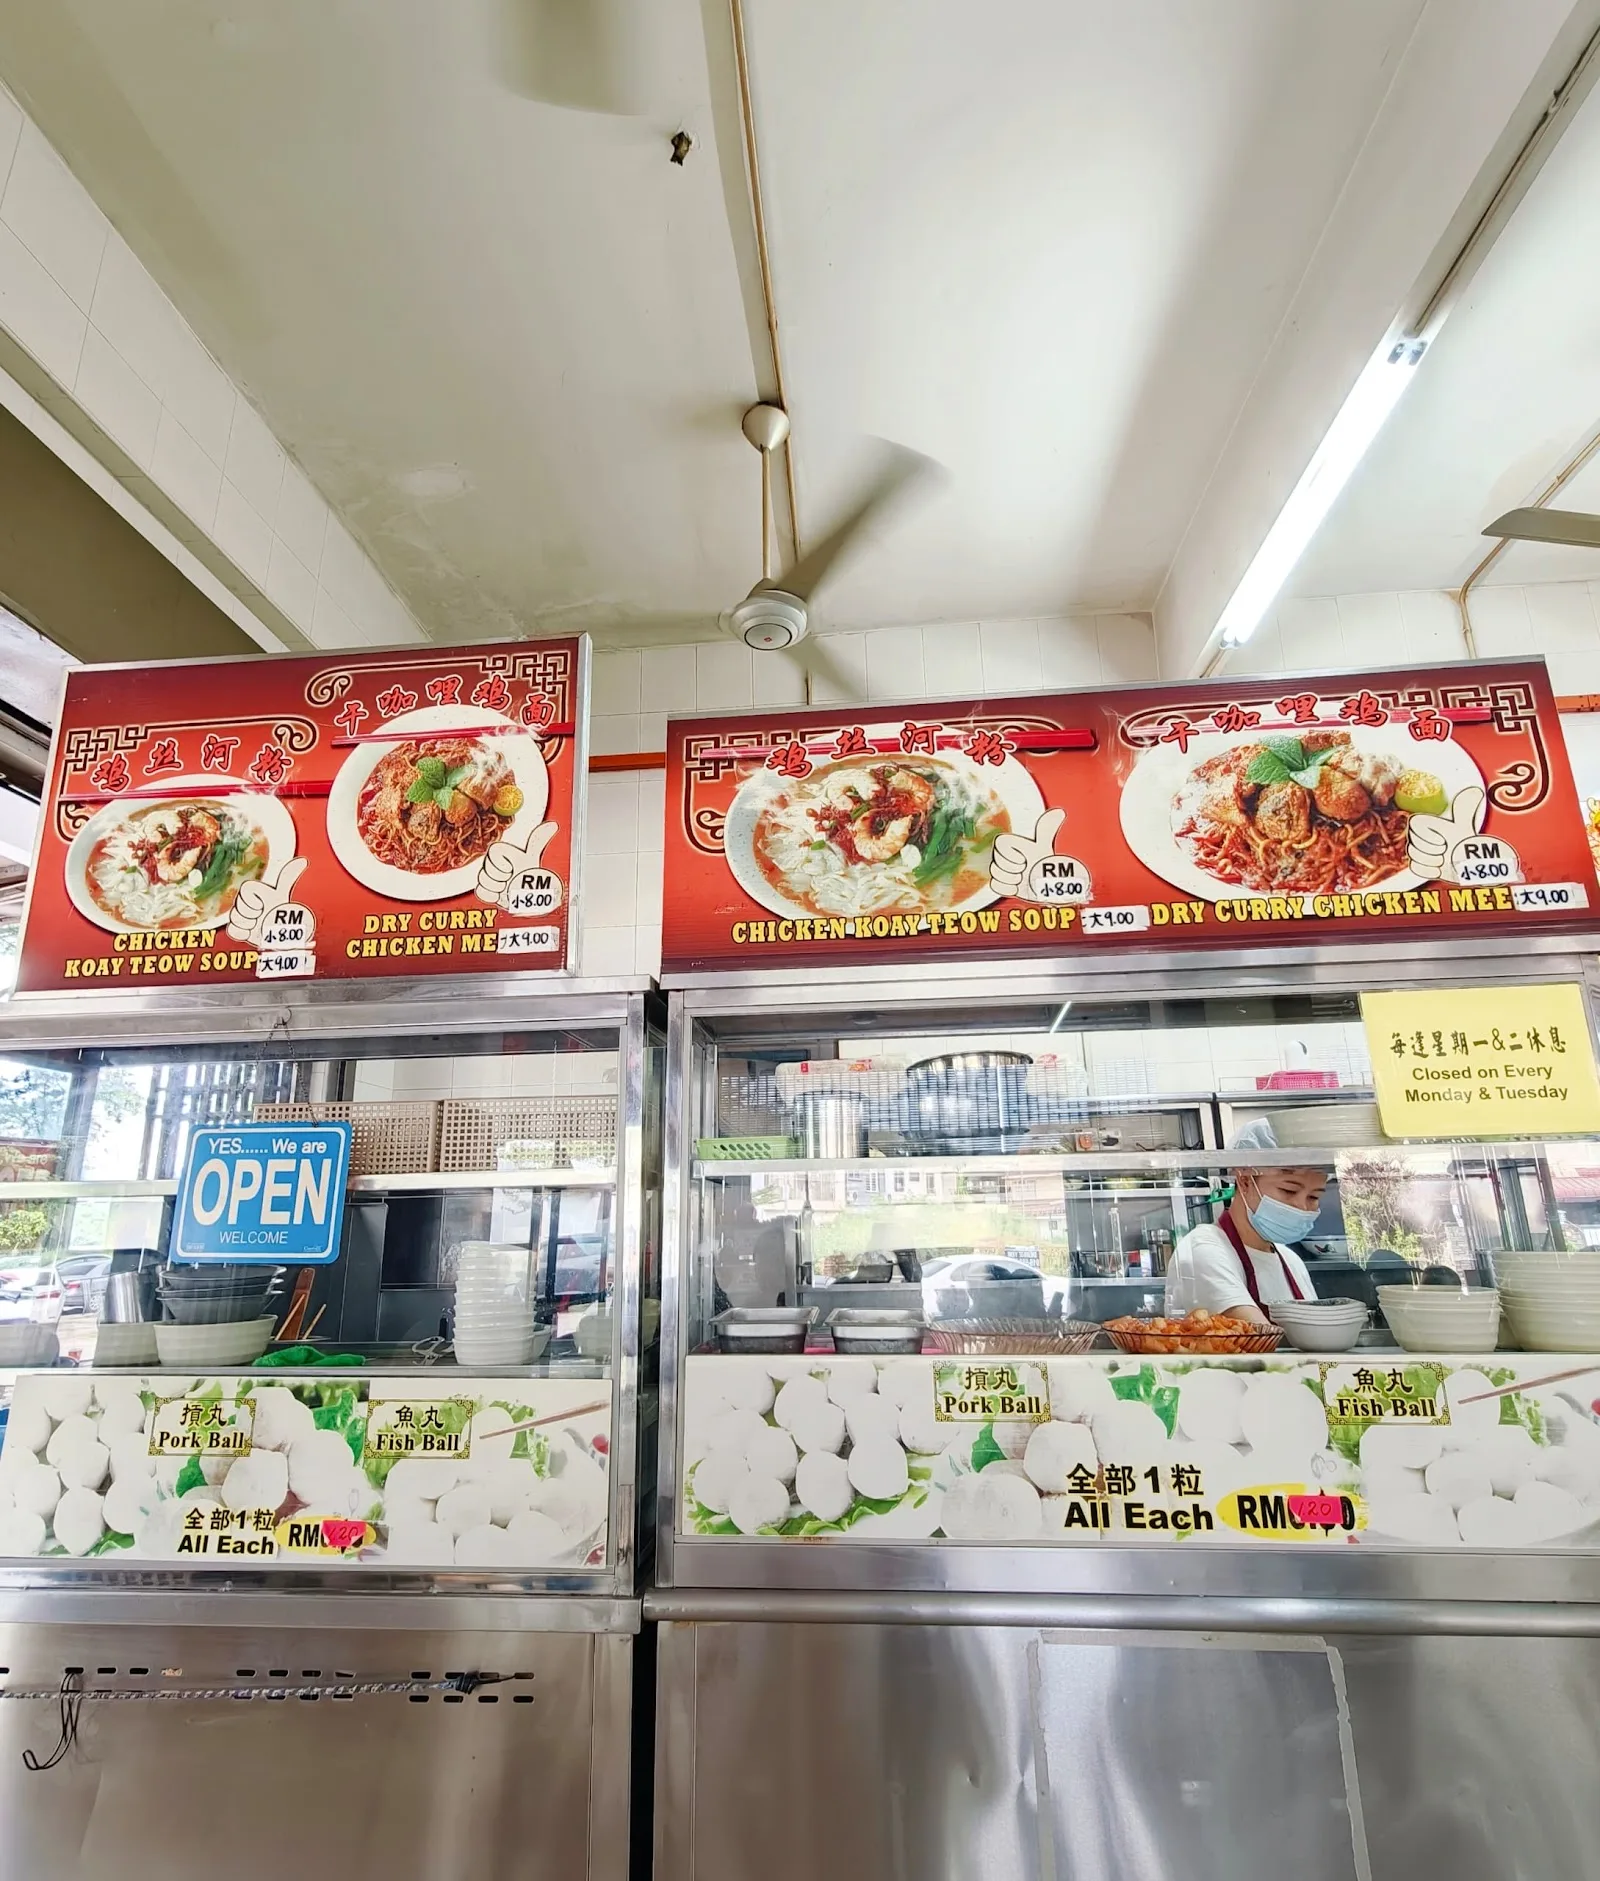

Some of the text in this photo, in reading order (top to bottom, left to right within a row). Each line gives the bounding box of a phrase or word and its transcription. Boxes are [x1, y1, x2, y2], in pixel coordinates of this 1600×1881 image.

[337, 676, 555, 735] 干咖哩鸡面
[1163, 691, 1452, 753] 干咖哩鸡面
[767, 722, 1016, 777] 鸡丝河粉
[95, 737, 290, 792] 鸡丝河粉
[1464, 843, 1500, 859] RM
[1042, 863, 1074, 877] RM
[521, 875, 551, 889] RM
[275, 910, 303, 924] RM
[1152, 887, 1512, 925] DRY CURRY CHICKEN MEE
[364, 909, 497, 934] DRY CURRY
[732, 907, 1076, 943] CHICKEN KOAY TEOW SOUP
[114, 929, 216, 951] CHICKEN
[347, 936, 454, 958] CHICKEN
[64, 951, 259, 977] KOAY TEOW SOUP
[1412, 1065, 1552, 1081] Closed on Every
[1405, 1085, 1568, 1104] Monday & Tuesday
[272, 1138, 296, 1154] We
[302, 1141, 327, 1154] are
[193, 1158, 332, 1226] OPEN
[220, 1231, 288, 1244] WELCOME
[1352, 1367, 1413, 1393] 魚丸
[944, 1396, 1041, 1413] Pork Ball
[1337, 1398, 1436, 1416] Fish Ball
[393, 1405, 444, 1428] 魚丸
[158, 1432, 245, 1449] Pork Ball
[376, 1434, 459, 1451] Fish Ball
[1064, 1502, 1111, 1528] All
[1124, 1502, 1214, 1530] Each
[177, 1535, 208, 1553] All
[217, 1536, 274, 1555] Each
